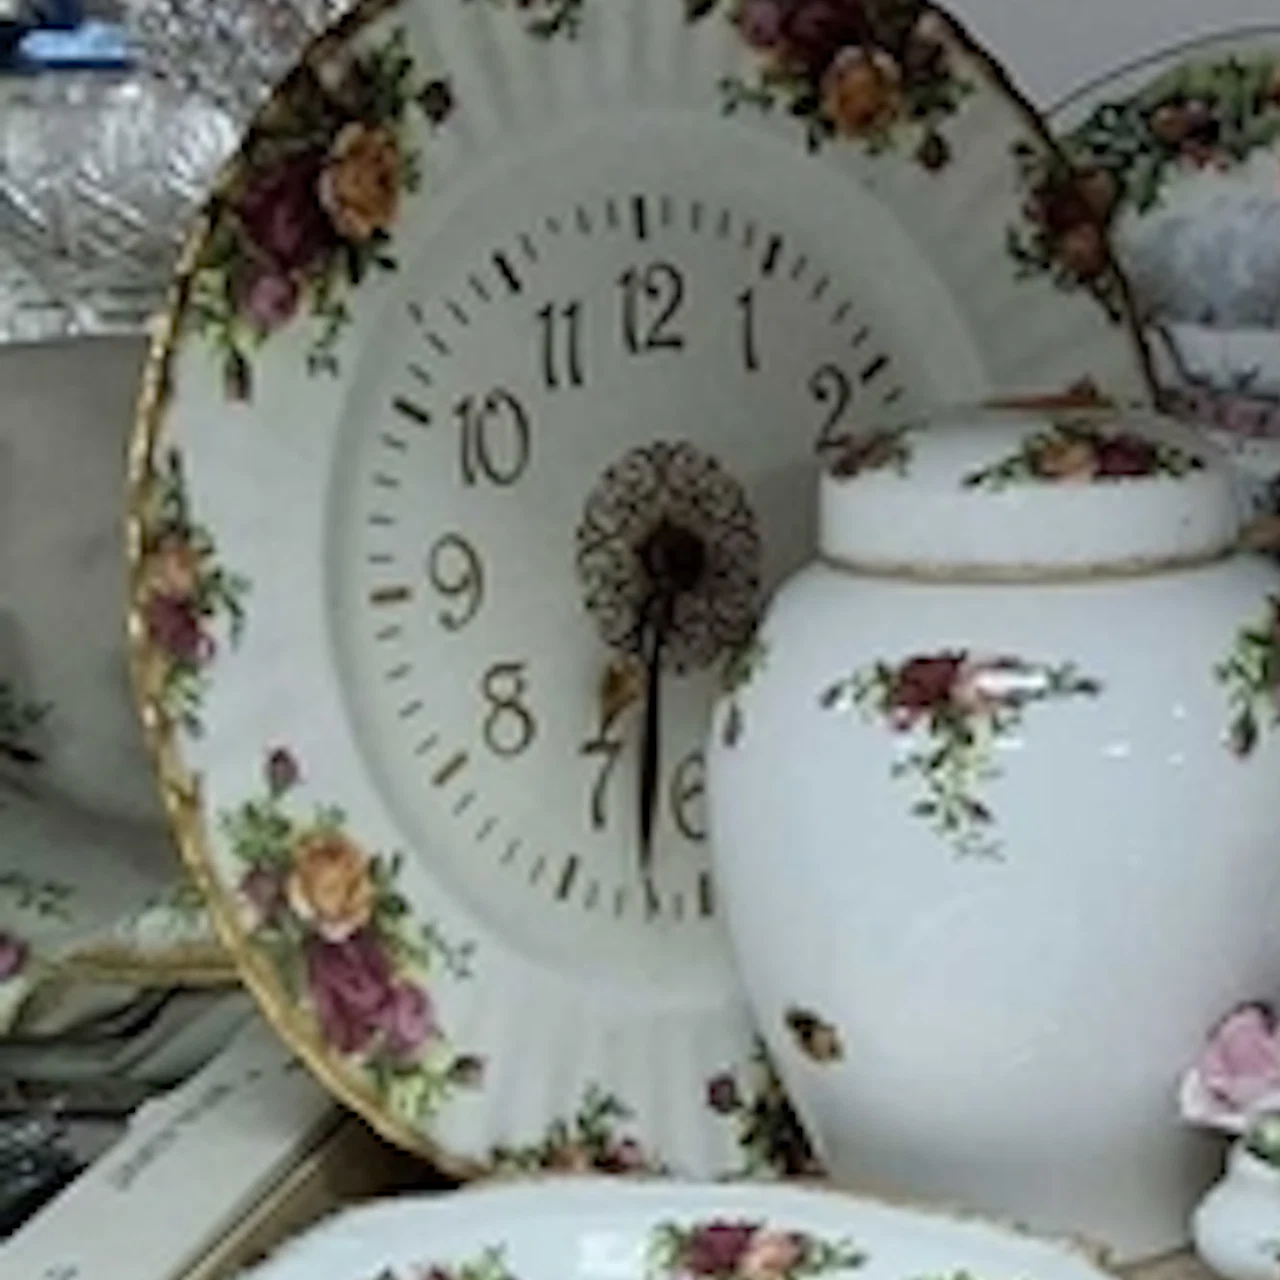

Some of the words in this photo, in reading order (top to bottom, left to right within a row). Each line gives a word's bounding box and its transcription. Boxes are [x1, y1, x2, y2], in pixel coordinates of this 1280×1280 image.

[536, 300, 583, 390] 11
[617, 262, 686, 356] 12
[736, 287, 760, 372] 1
[452, 388, 531, 487] 10
[808, 363, 854, 452] 2
[427, 533, 484, 630] 9
[482, 662, 536, 756] 8
[578, 734, 626, 830] 7
